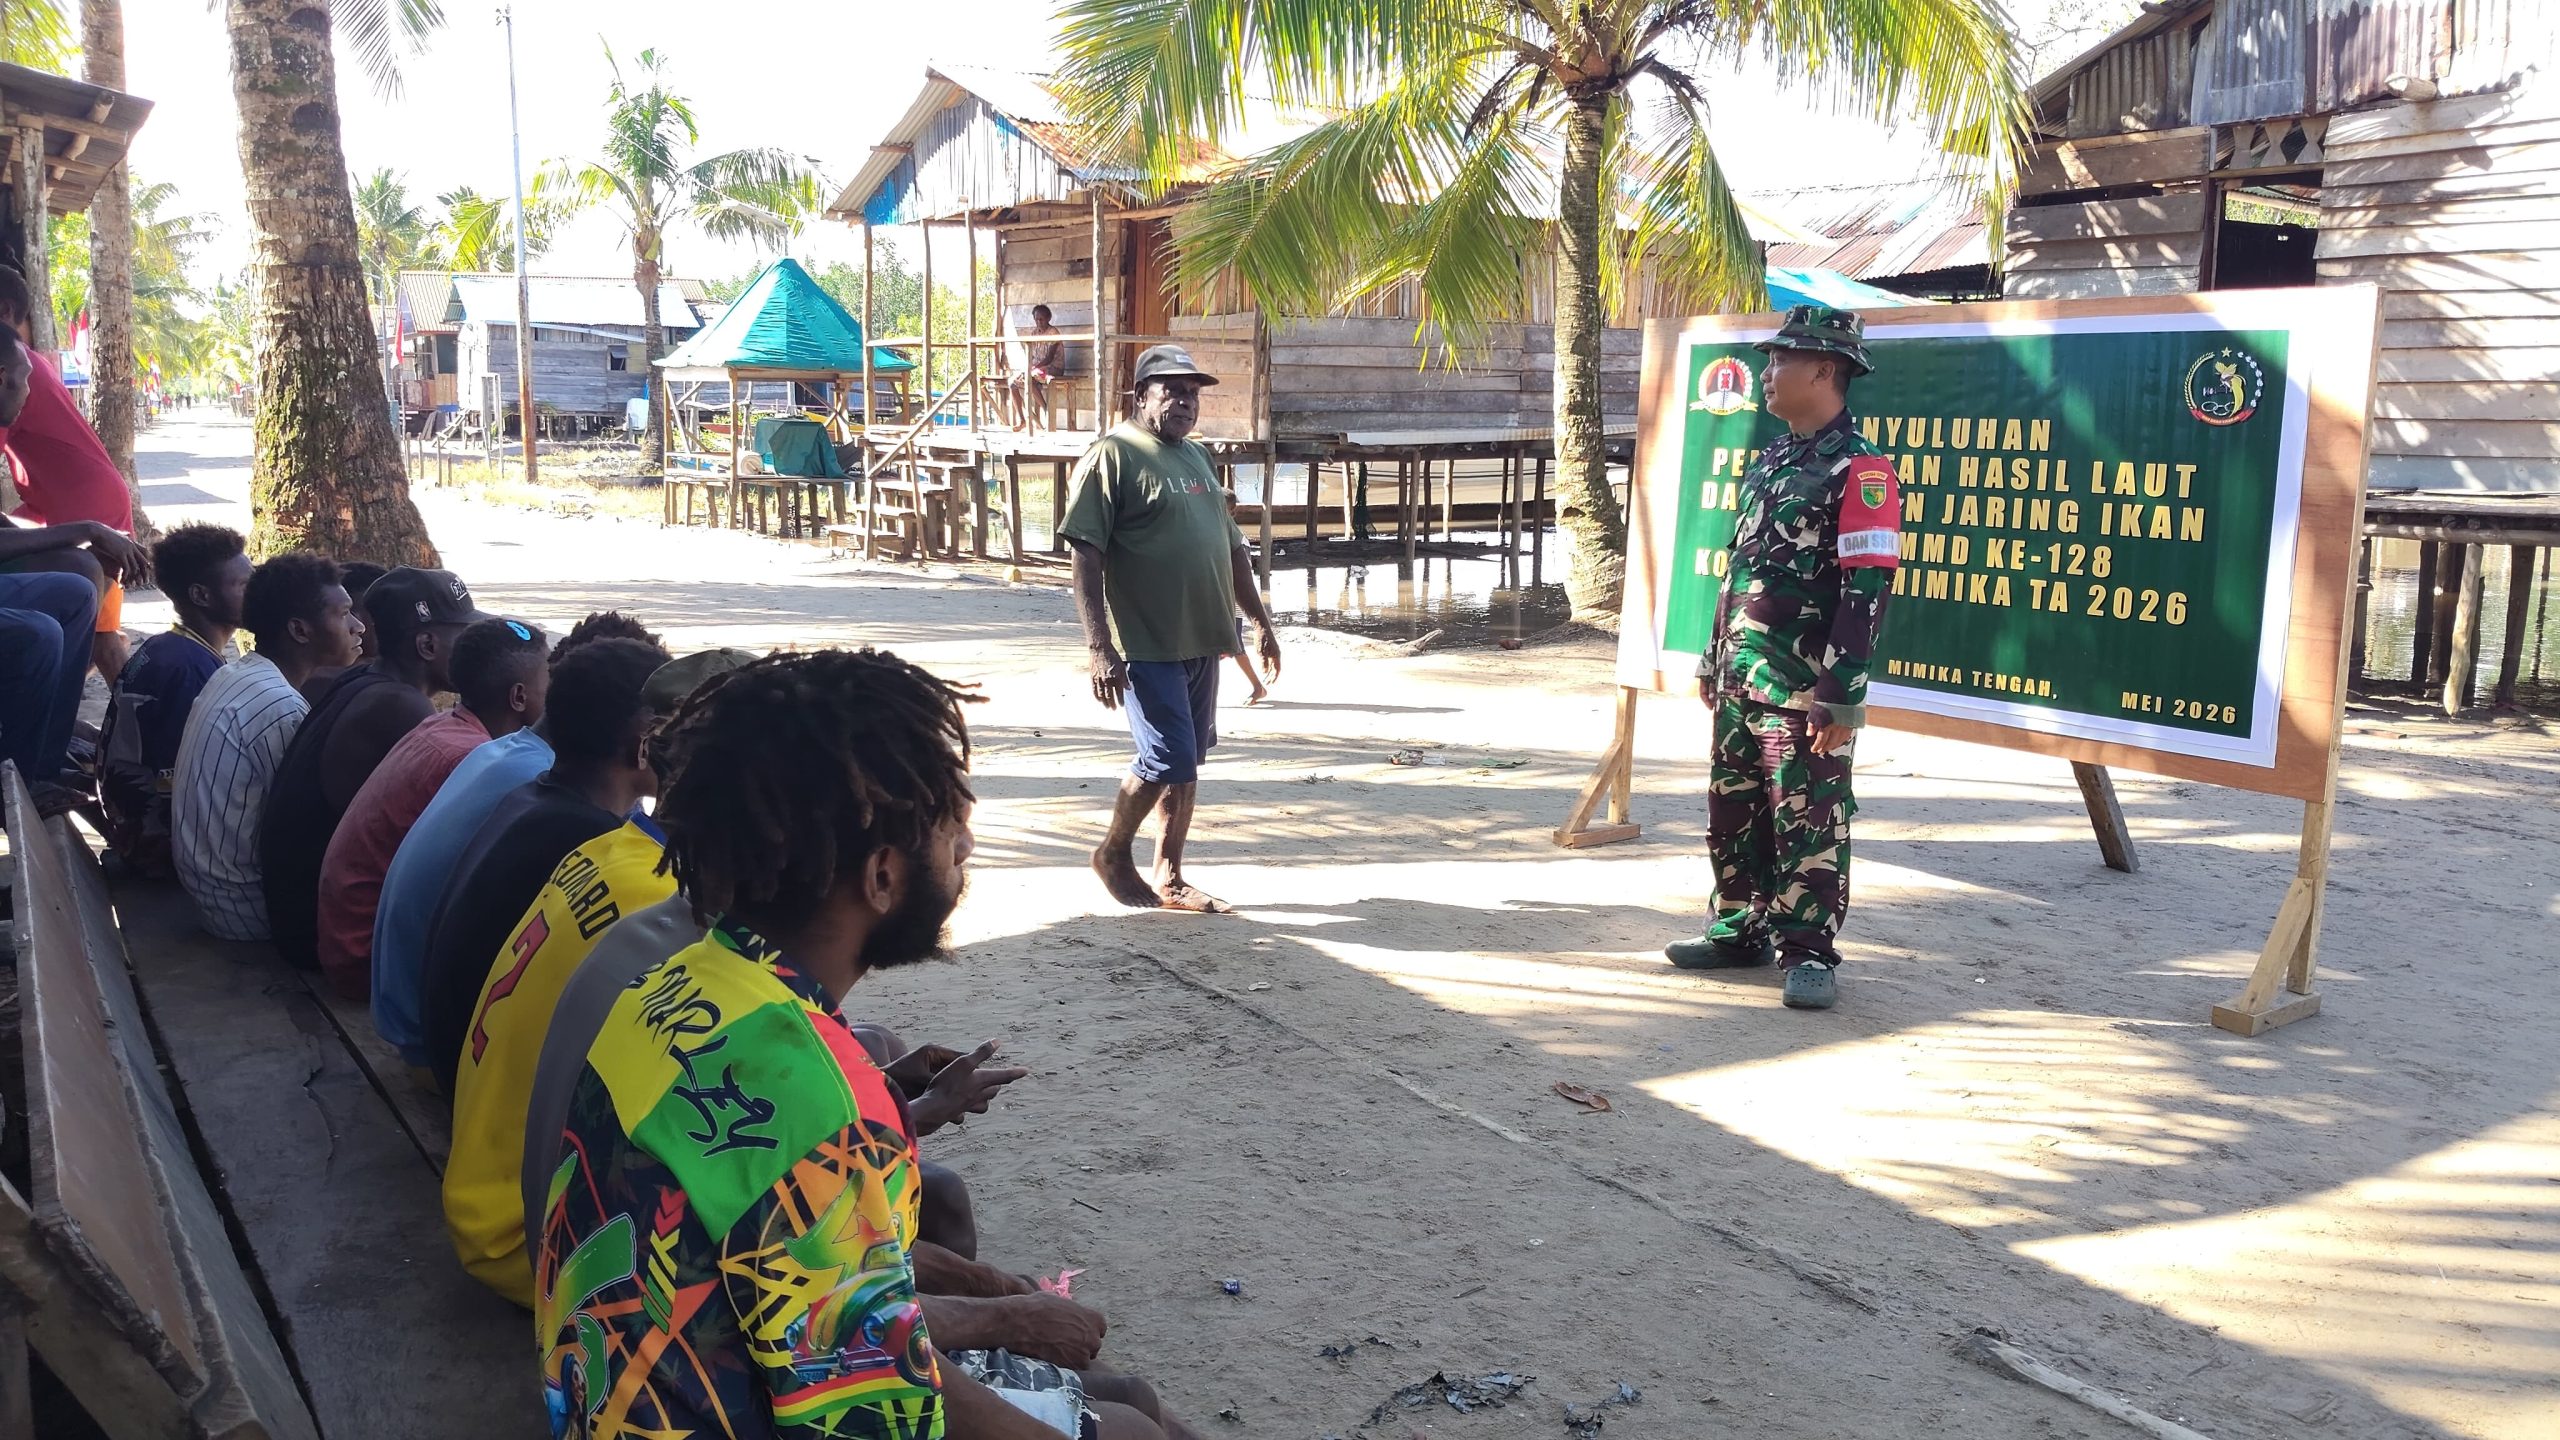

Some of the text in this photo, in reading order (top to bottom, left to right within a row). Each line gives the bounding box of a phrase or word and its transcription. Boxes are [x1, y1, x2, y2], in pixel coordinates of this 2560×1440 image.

[1853, 416, 2051, 452] NYULUHAN
[1712, 447, 1760, 477] PE
[1958, 455, 2070, 493] HASIL
[2090, 460, 2198, 499] LAUT
[1701, 481, 1737, 511] DA
[1941, 494, 2080, 534] JARING
[2100, 502, 2206, 542] IKAN
[1694, 531, 2113, 578] KO MMD KE-128
[1844, 534, 1869, 552] DAN
[2030, 579, 2069, 614] TA
[2086, 584, 2189, 626] 2026
[1888, 659, 2237, 725] MIMIKA TENGAH, MEI 2026
[551, 849, 620, 941] EONARD
[472, 908, 550, 1068] 7
